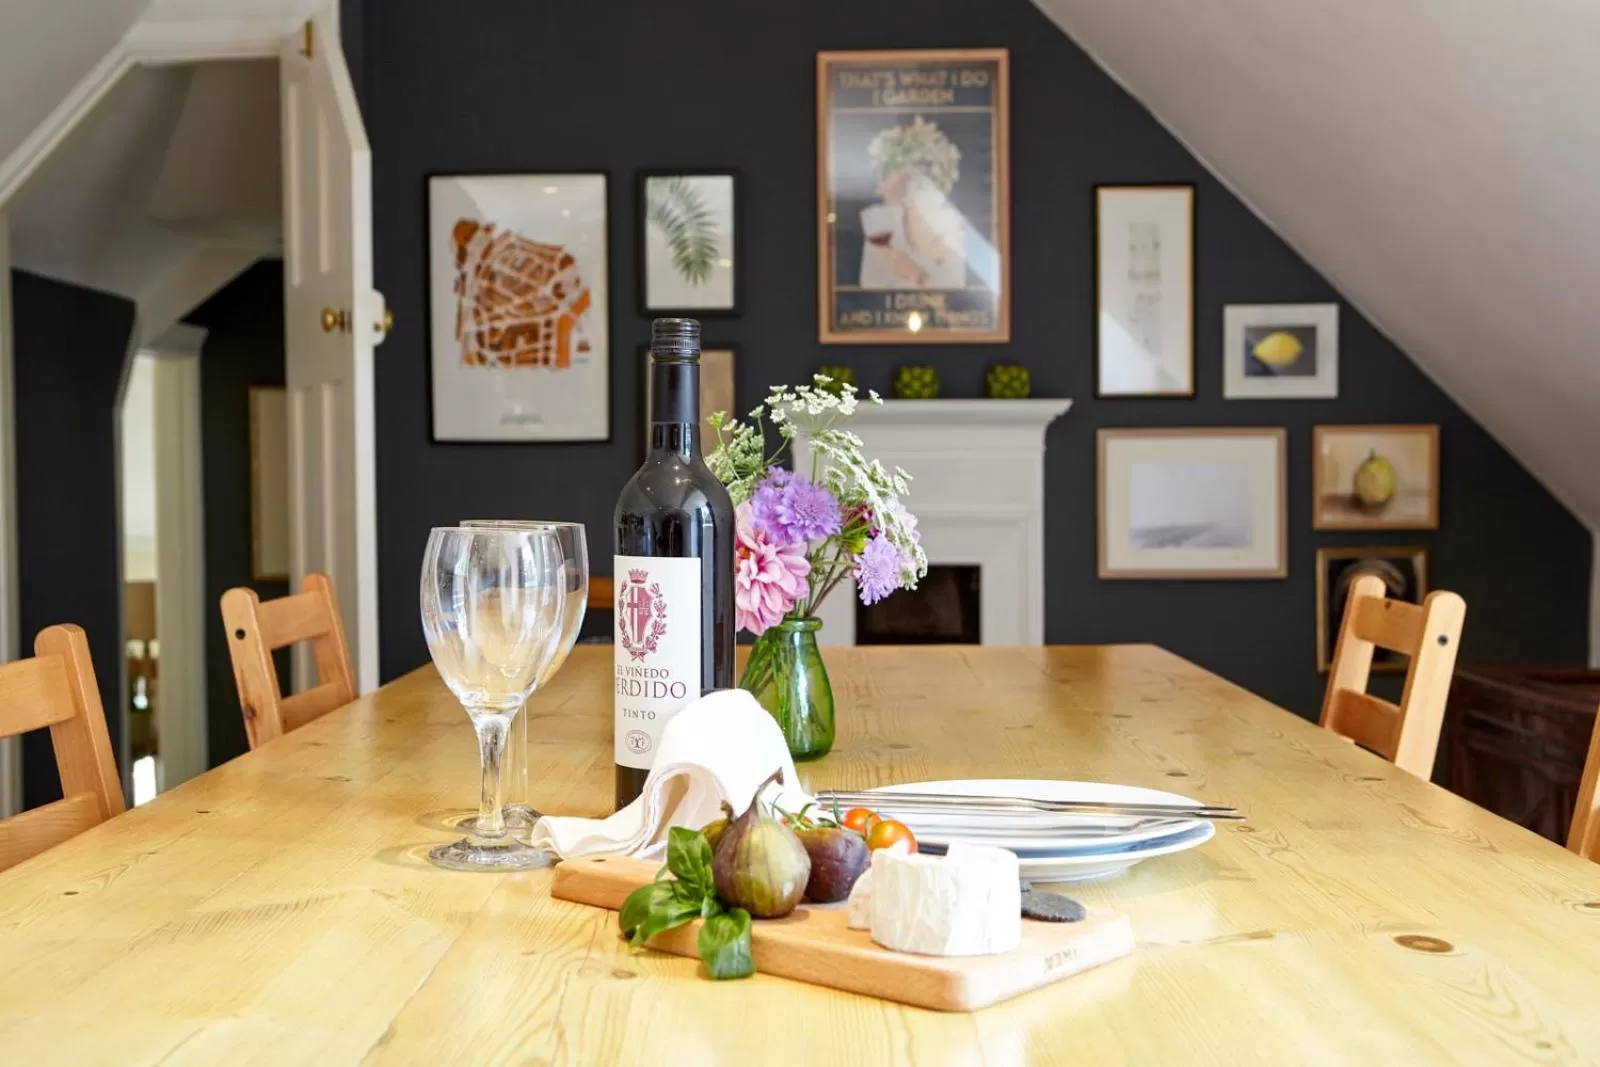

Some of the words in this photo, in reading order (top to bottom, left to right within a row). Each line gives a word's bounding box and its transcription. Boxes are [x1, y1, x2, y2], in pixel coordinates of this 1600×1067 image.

[899, 70, 948, 87] WHAT
[951, 71, 958, 86] I
[960, 69, 989, 87] DO
[872, 88, 879, 105] I
[882, 87, 954, 105] GARDEN
[885, 294, 892, 309] I
[625, 665, 670, 679] VIÑEDO
[616, 676, 687, 699] ERDIDO
[622, 708, 656, 720] TINTO
